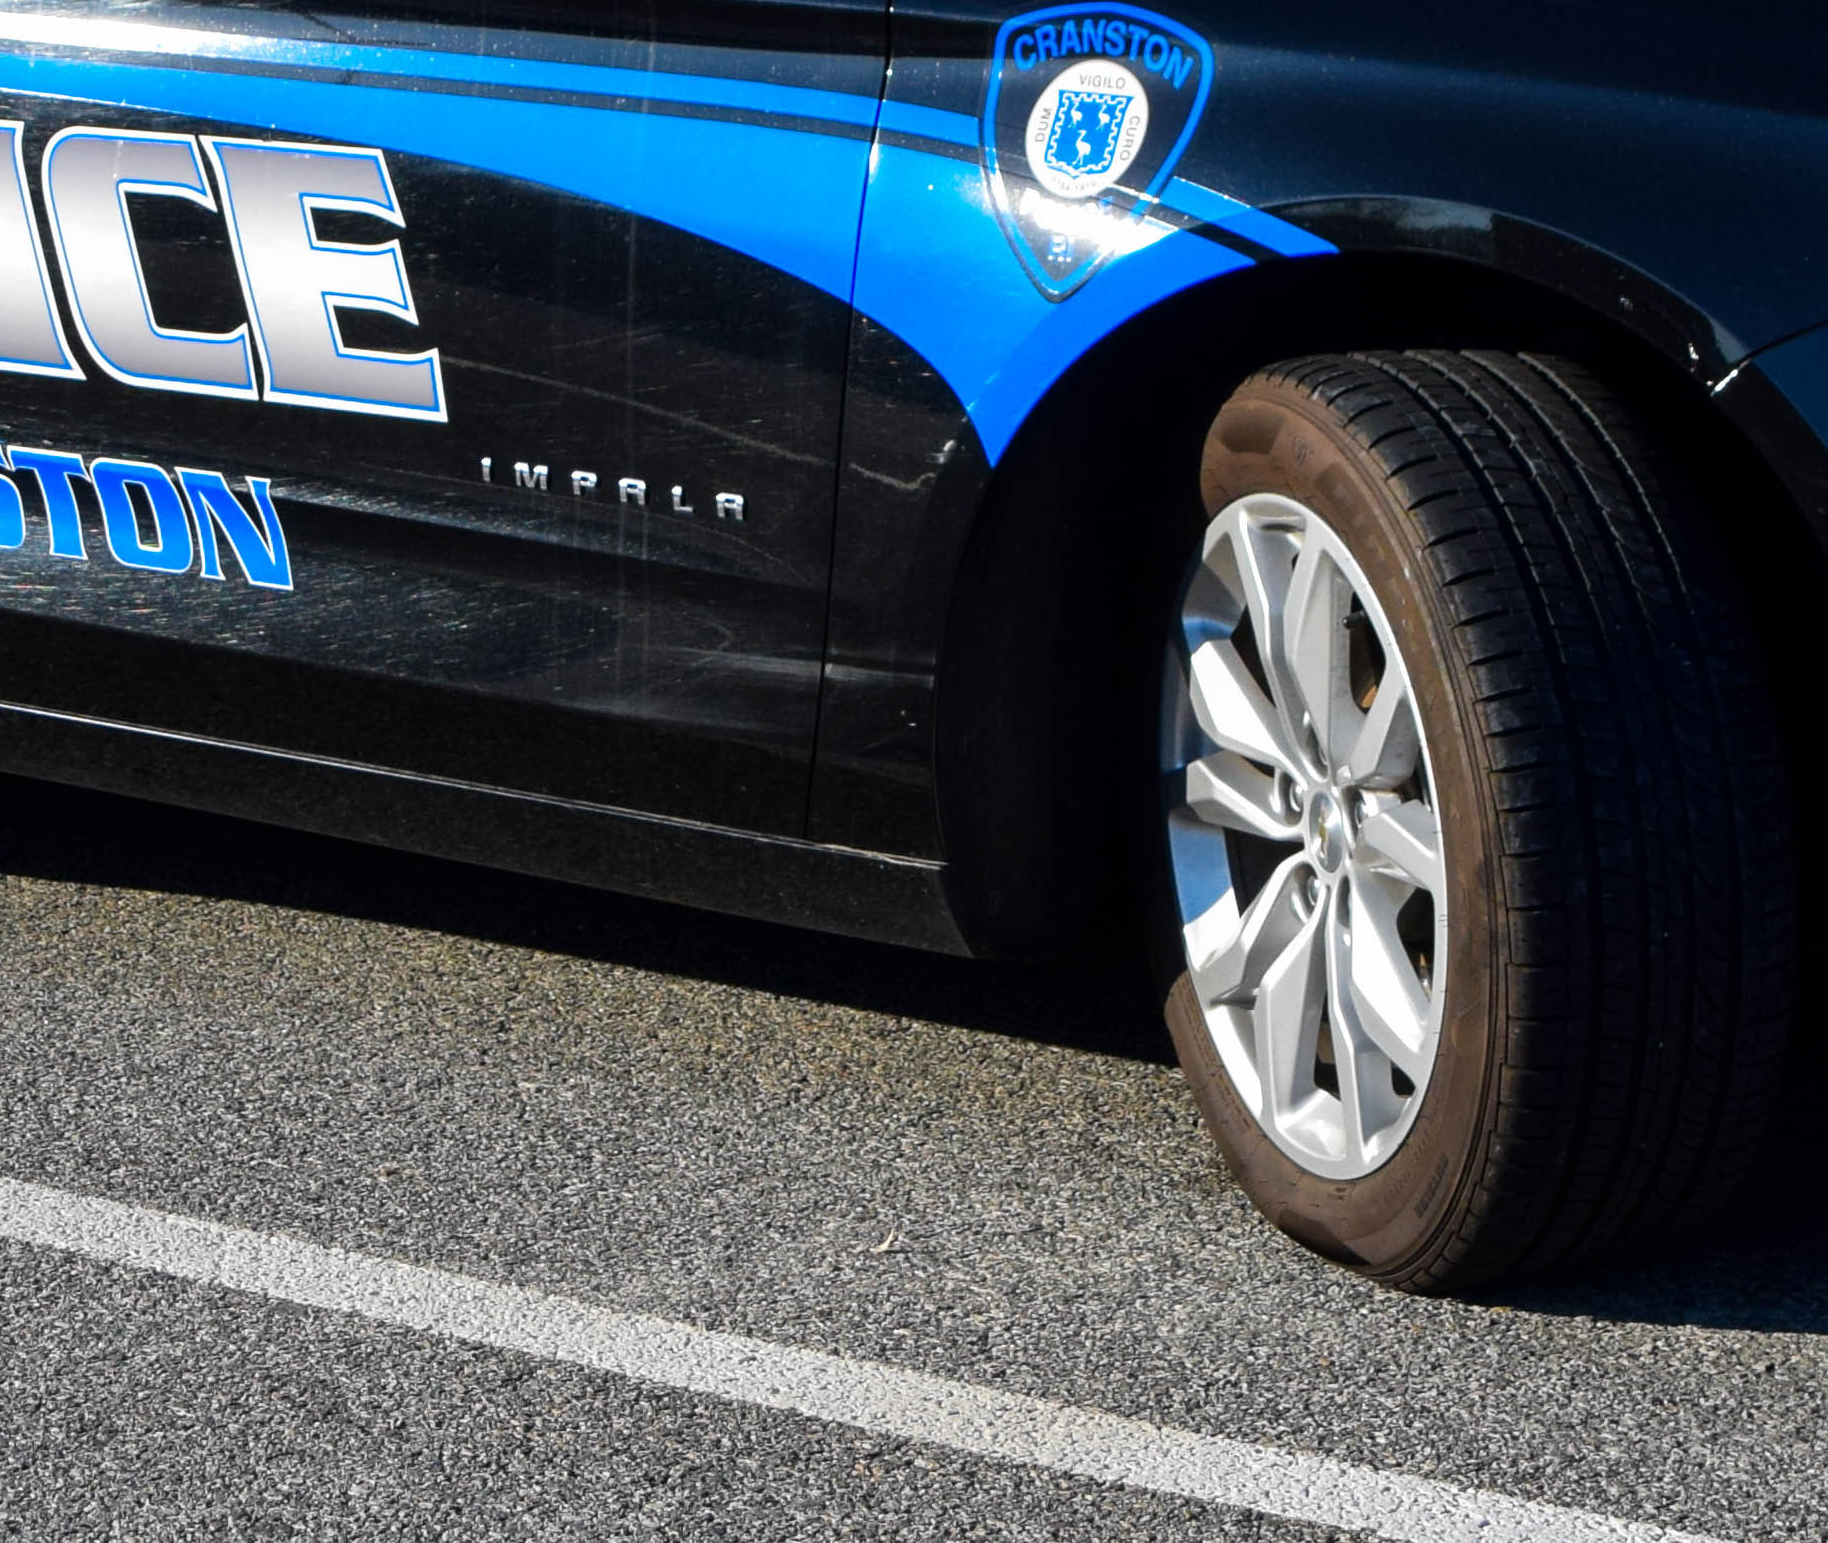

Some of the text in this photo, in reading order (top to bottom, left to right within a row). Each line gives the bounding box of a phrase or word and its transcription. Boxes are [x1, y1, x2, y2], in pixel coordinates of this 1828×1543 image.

[1012, 18, 1194, 90] CRANSTON
[1034, 73, 1141, 161] DUM VIGILO CURO
[481, 457, 744, 520] IMPALA
